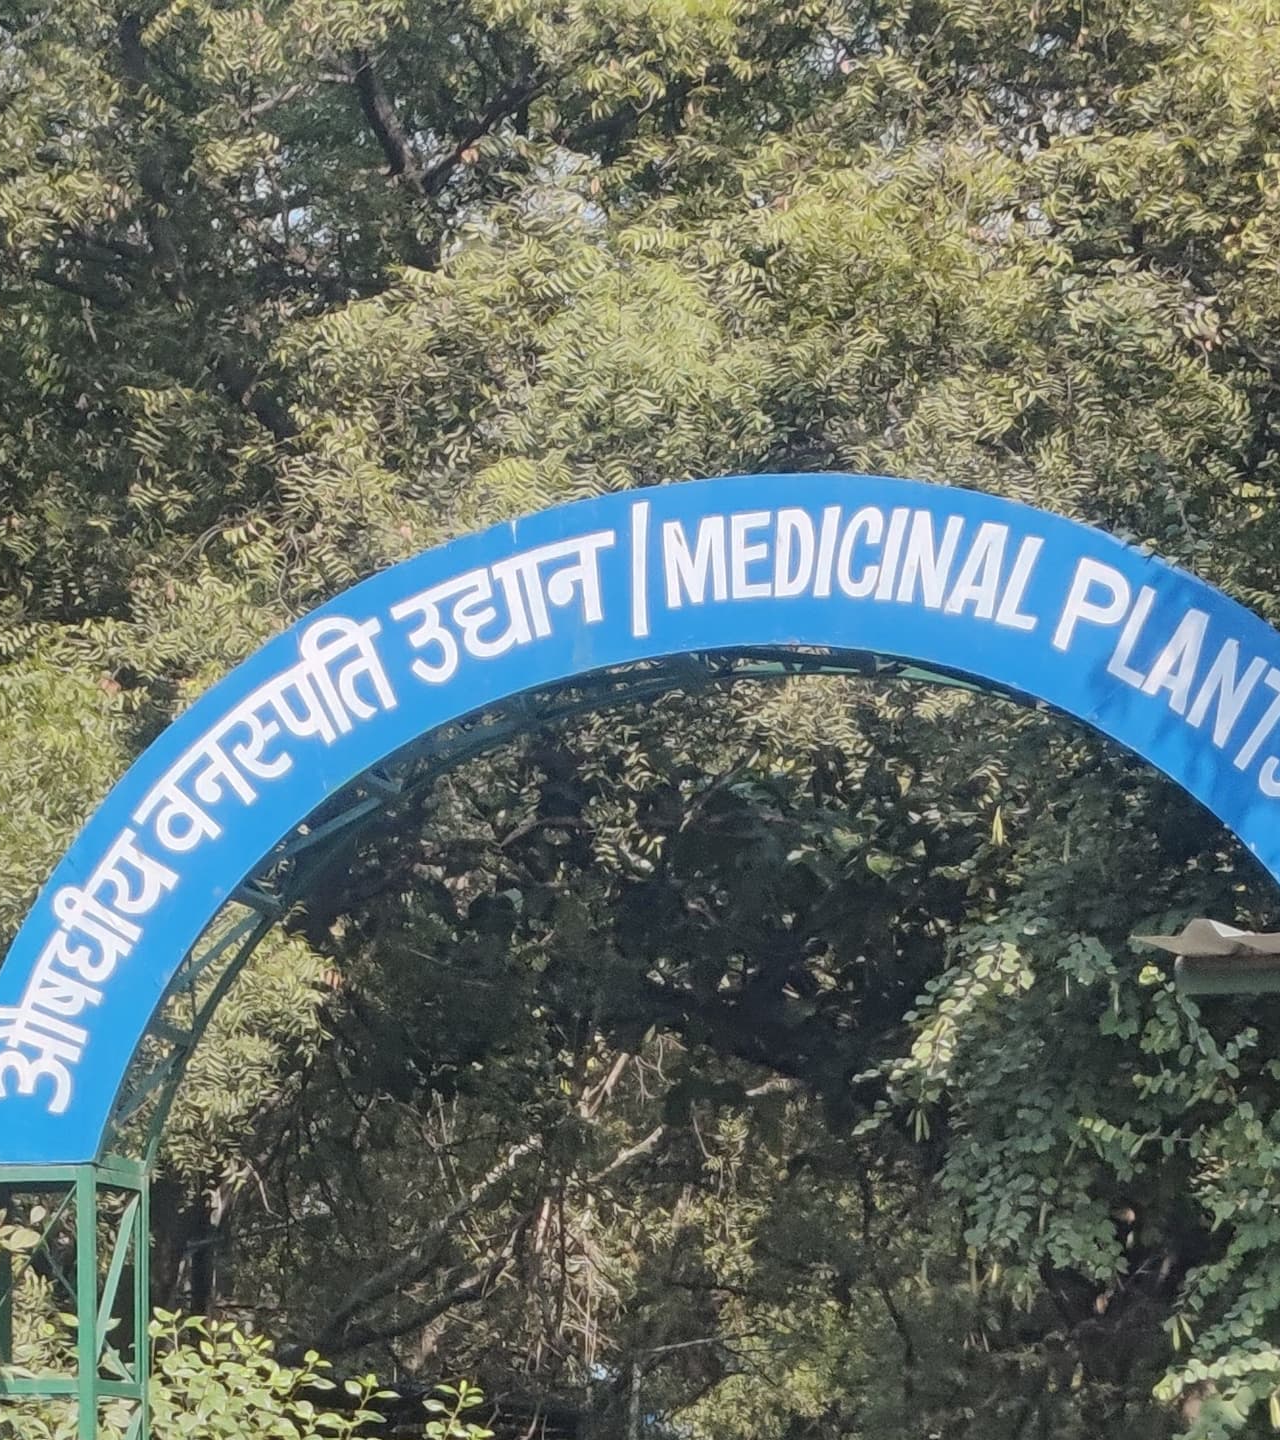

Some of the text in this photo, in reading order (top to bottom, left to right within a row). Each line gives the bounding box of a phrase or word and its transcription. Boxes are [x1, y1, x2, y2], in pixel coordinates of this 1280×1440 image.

[663, 505, 1045, 630] MEDICINAL
[133, 617, 397, 851] वनस्पति
[390, 530, 615, 684] उद्यान
